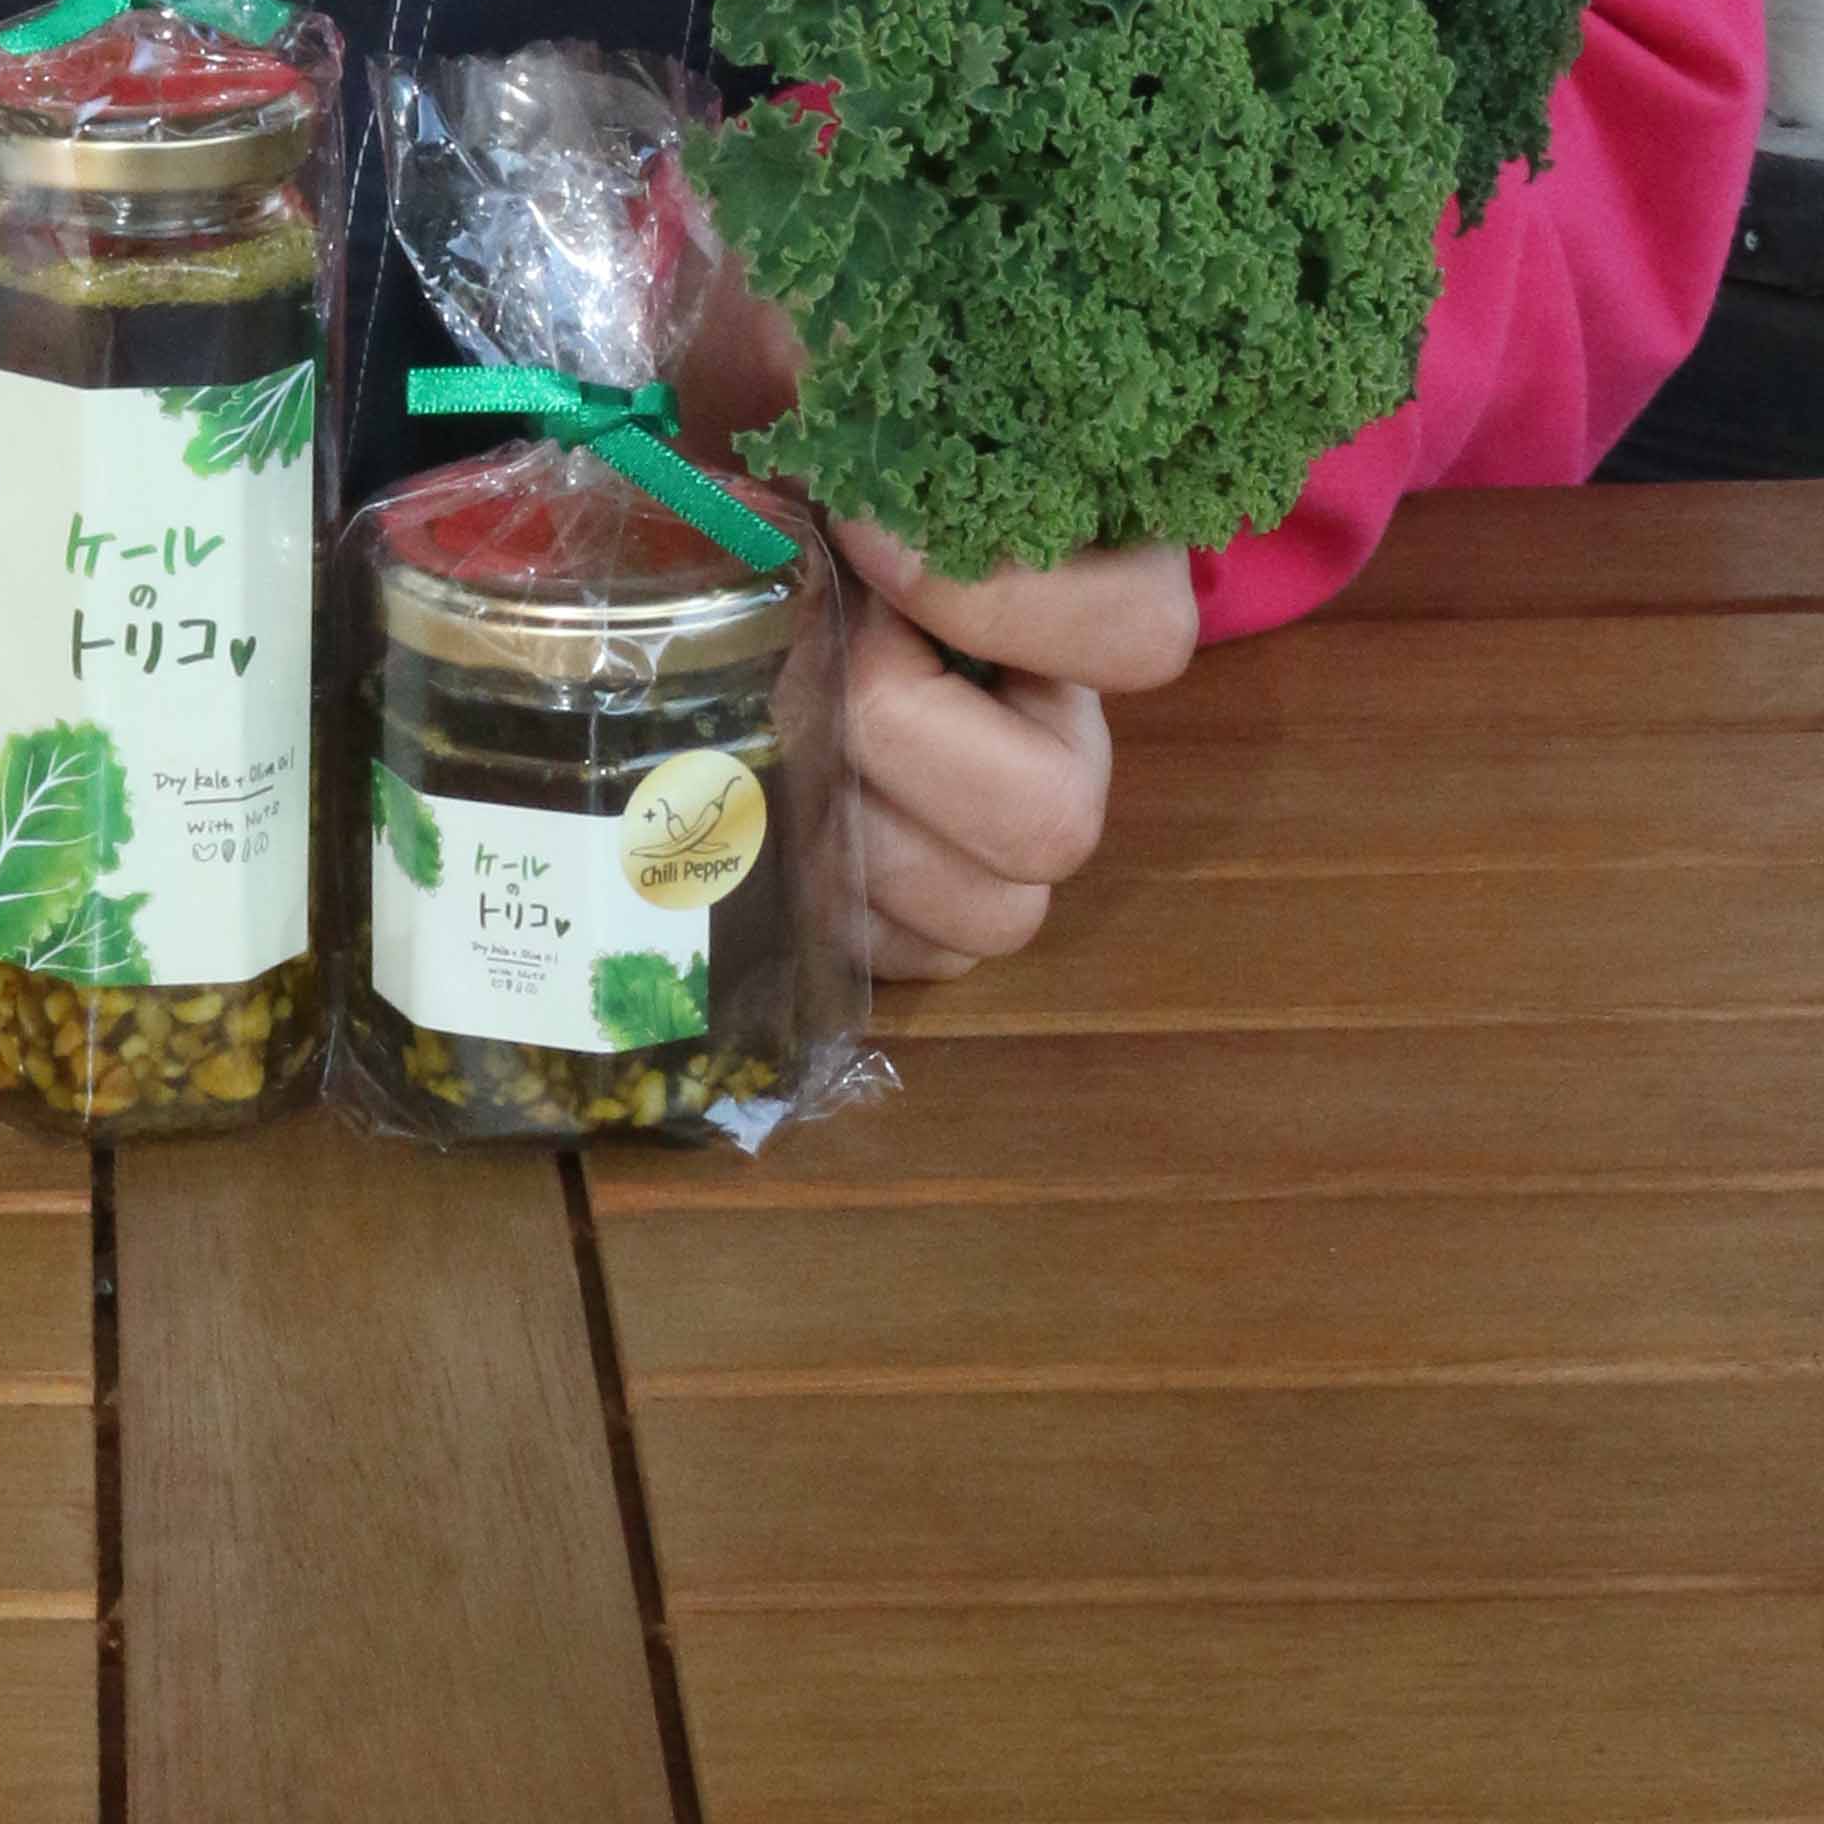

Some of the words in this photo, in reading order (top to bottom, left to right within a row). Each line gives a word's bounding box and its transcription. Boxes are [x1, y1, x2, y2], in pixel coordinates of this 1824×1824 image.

[65, 511, 225, 579] ケール
[129, 583, 158, 610] の
[71, 608, 218, 681] トリコ
[152, 772, 187, 796] Dry
[475, 843, 551, 881] ケール
[639, 861, 678, 888] Chili
[683, 855, 742, 883] Pepper
[506, 883, 521, 897] の
[479, 892, 548, 929] トリコ
